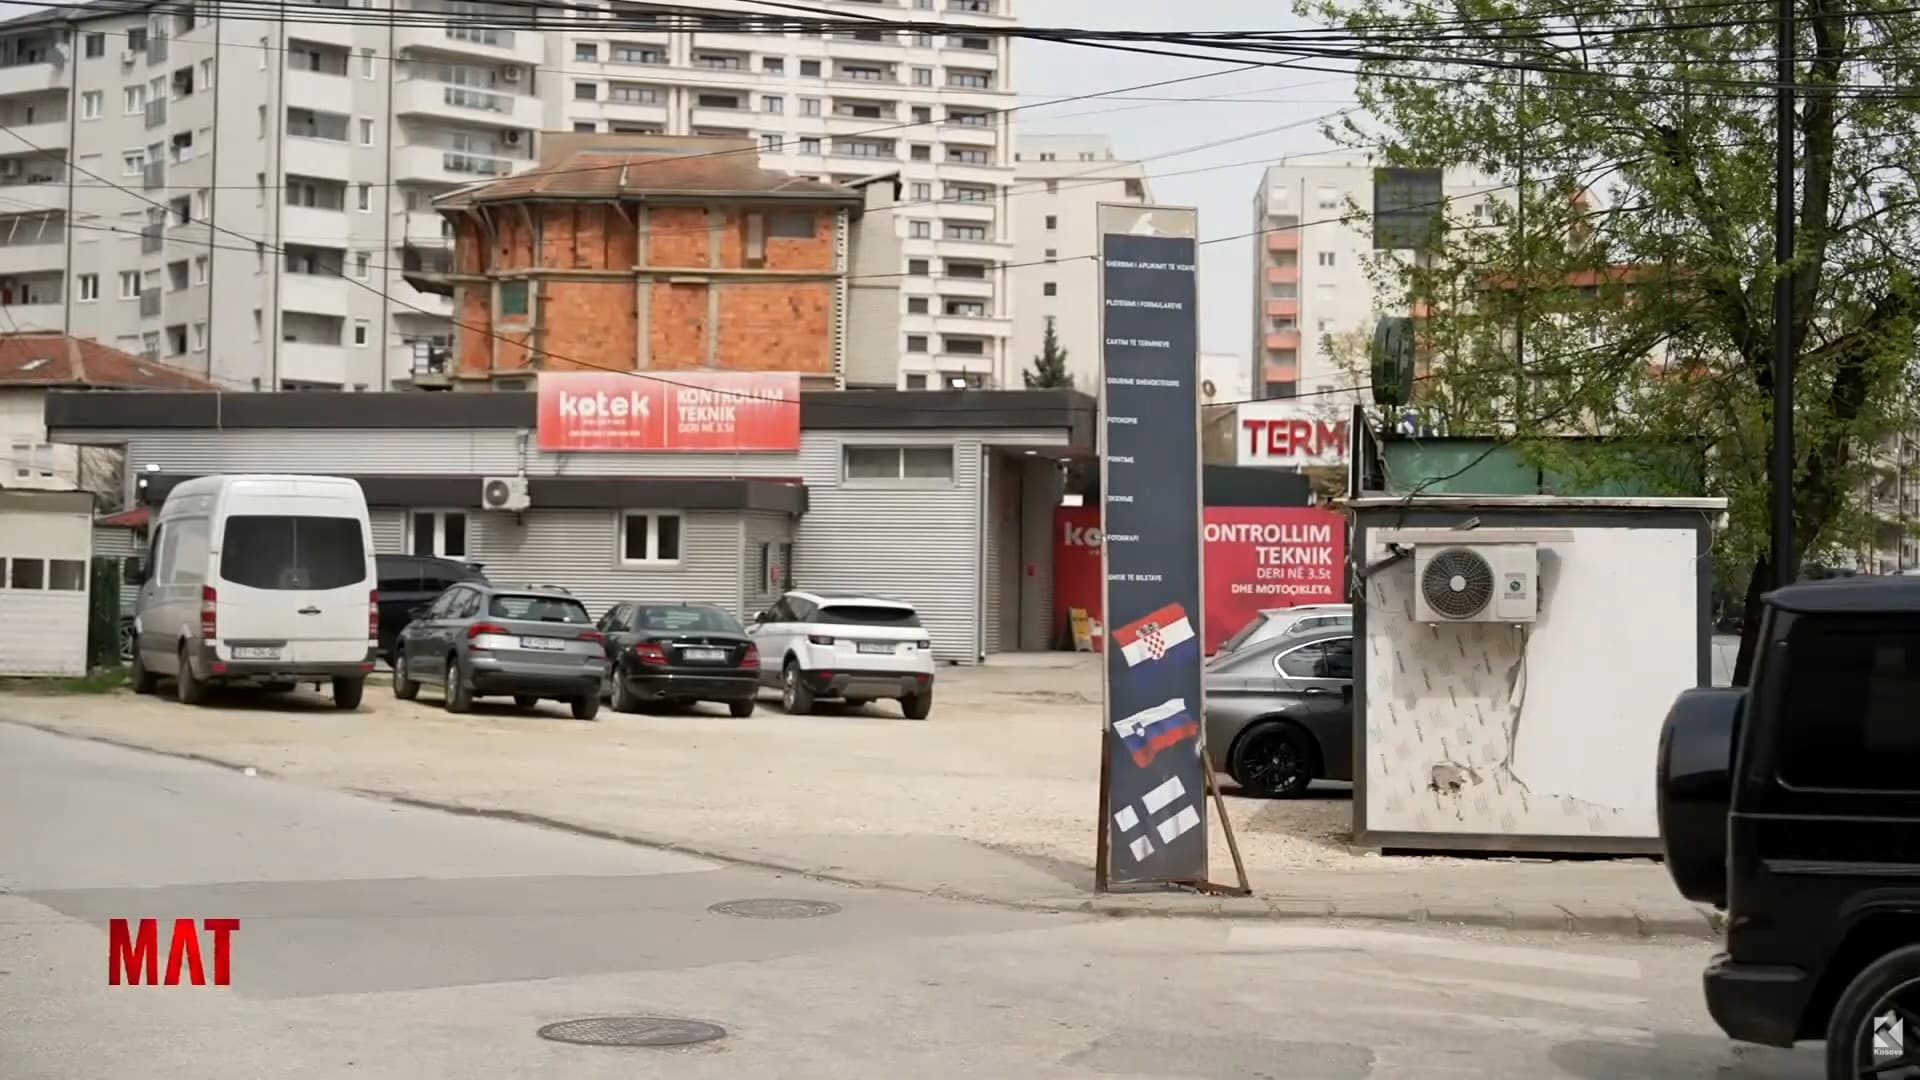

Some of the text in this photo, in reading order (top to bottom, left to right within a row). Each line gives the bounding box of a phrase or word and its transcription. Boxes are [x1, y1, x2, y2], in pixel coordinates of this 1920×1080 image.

[559, 391, 650, 417] kotek
[677, 387, 783, 405] KONTROLLIM
[678, 406, 736, 422] TEKNIK
[1243, 419, 1349, 456] TERM
[1064, 521, 1102, 547] ko
[1203, 523, 1330, 543] ONTROLLIM
[1256, 546, 1332, 565] TEKNIK
[1256, 567, 1284, 579] DERI
[1287, 565, 1304, 579] NË
[1231, 584, 1253, 595] DHE
